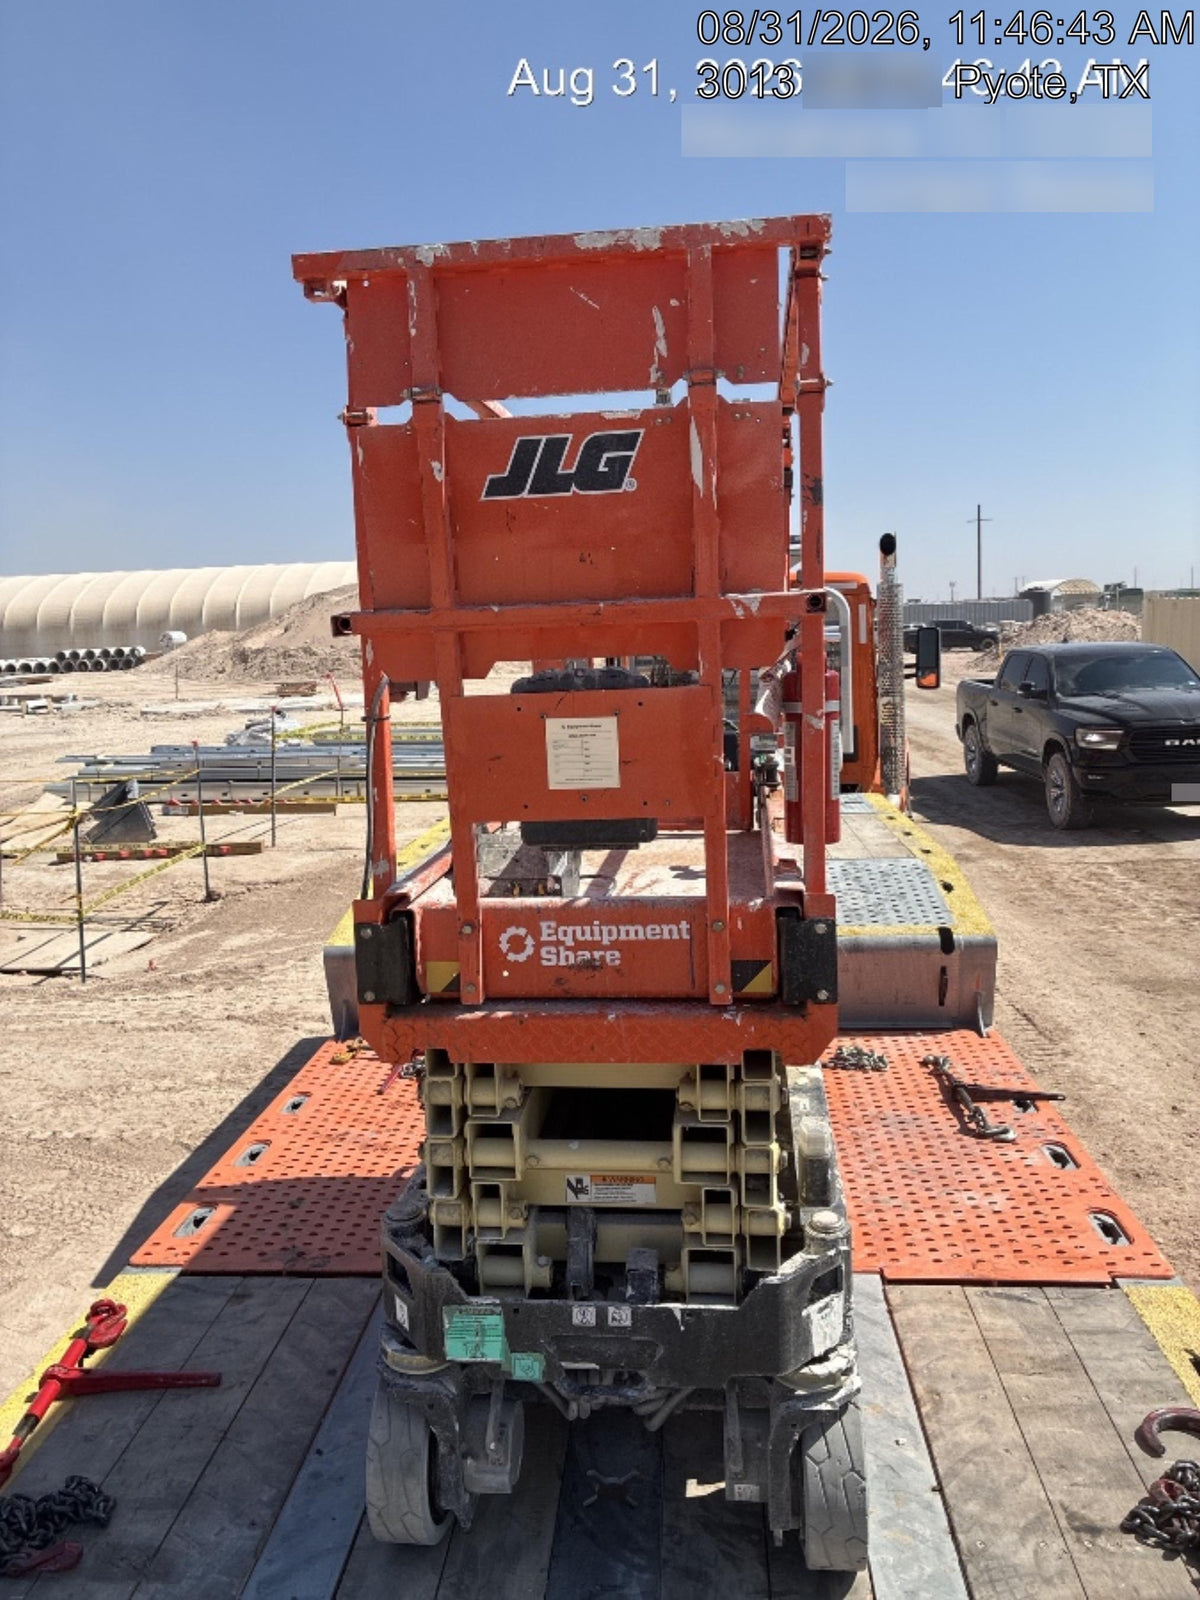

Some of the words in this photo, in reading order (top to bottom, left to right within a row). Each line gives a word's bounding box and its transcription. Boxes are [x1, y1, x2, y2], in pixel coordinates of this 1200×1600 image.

[480, 429, 645, 500] JLG
[539, 920, 691, 946] Equipment
[540, 945, 622, 967] Share
